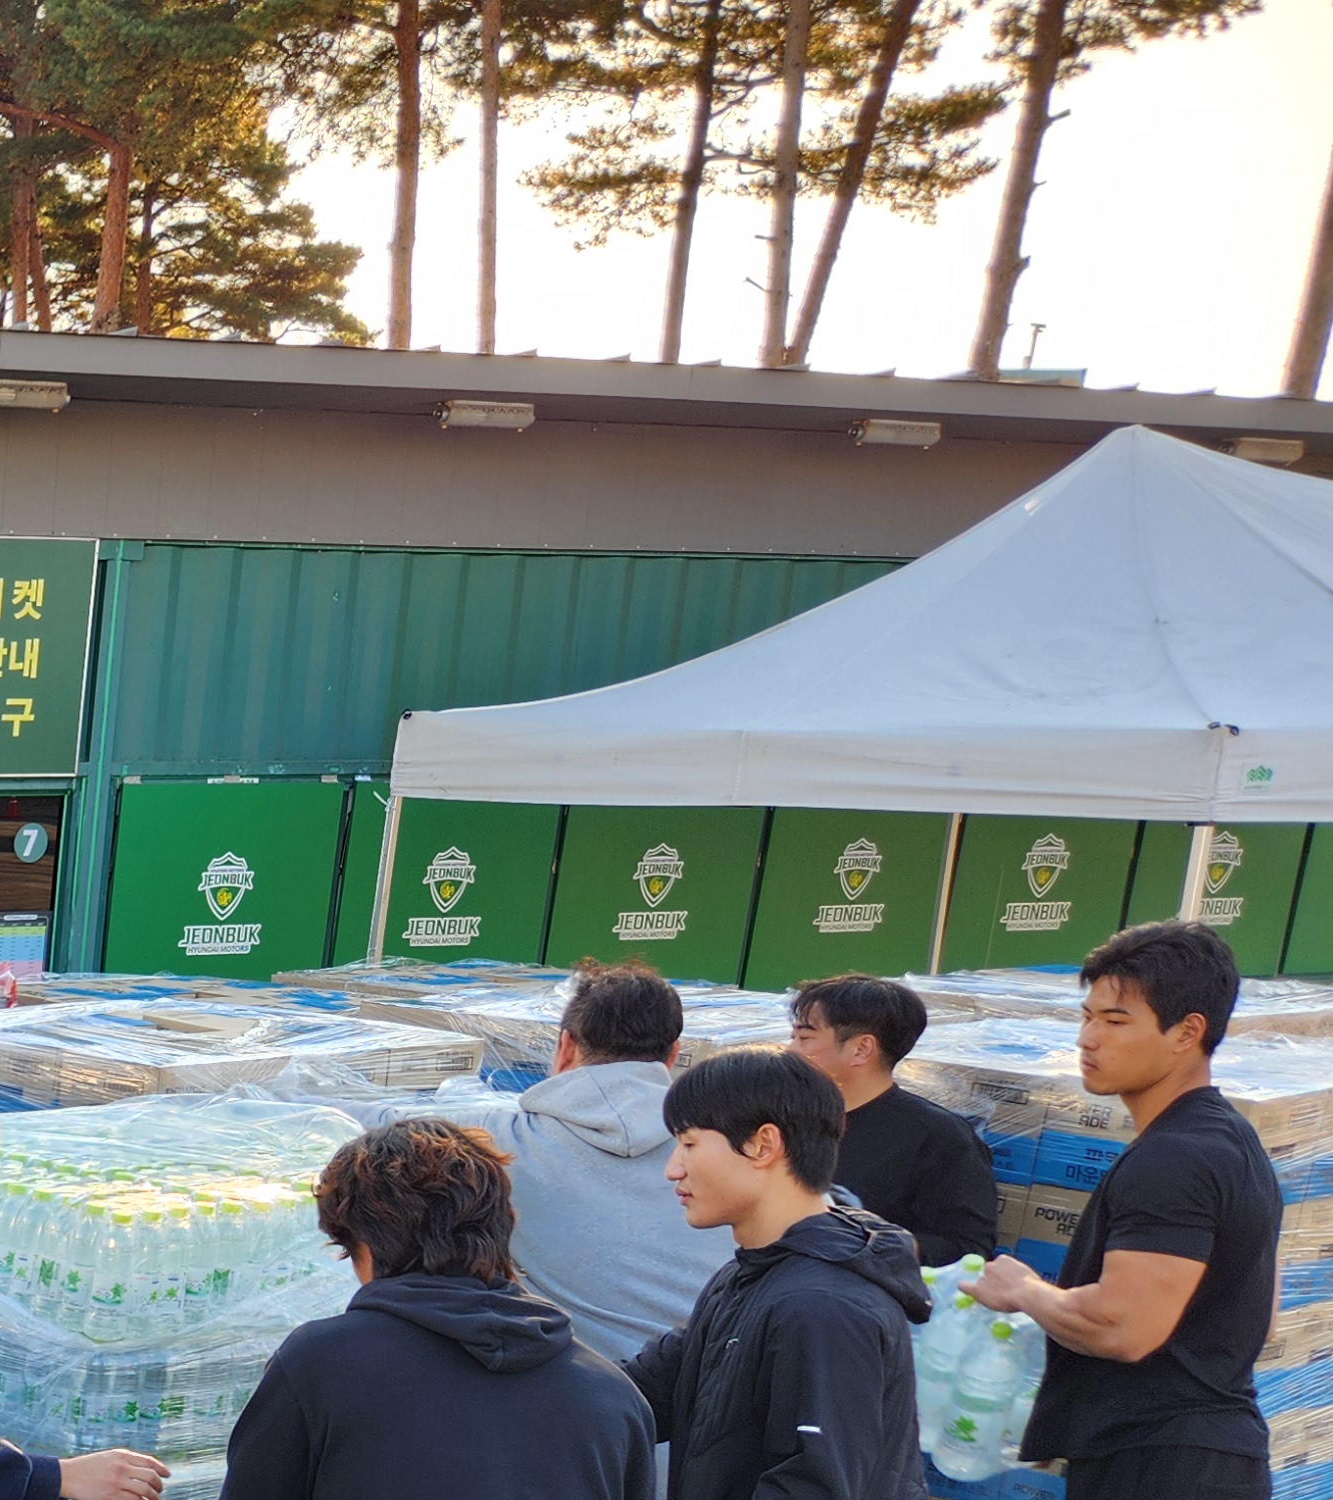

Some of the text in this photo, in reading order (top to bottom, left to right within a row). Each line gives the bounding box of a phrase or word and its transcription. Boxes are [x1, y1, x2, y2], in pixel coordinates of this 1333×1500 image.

[22, 829, 39, 857] 7
[835, 857, 880, 872] JEONBUK
[1023, 853, 1067, 868] JEONBUK
[424, 867, 474, 882] JEONBUK
[634, 863, 682, 879] JEONBUK
[200, 873, 252, 889] JEONBUK
[815, 906, 883, 923] JEONBUK
[1002, 903, 1069, 921] JEONBUK
[404, 918, 479, 936] JEONBUK
[615, 913, 686, 930] JEONBUK
[179, 925, 259, 945] JEONBUK
[1078, 1114, 1110, 1130] ADE
